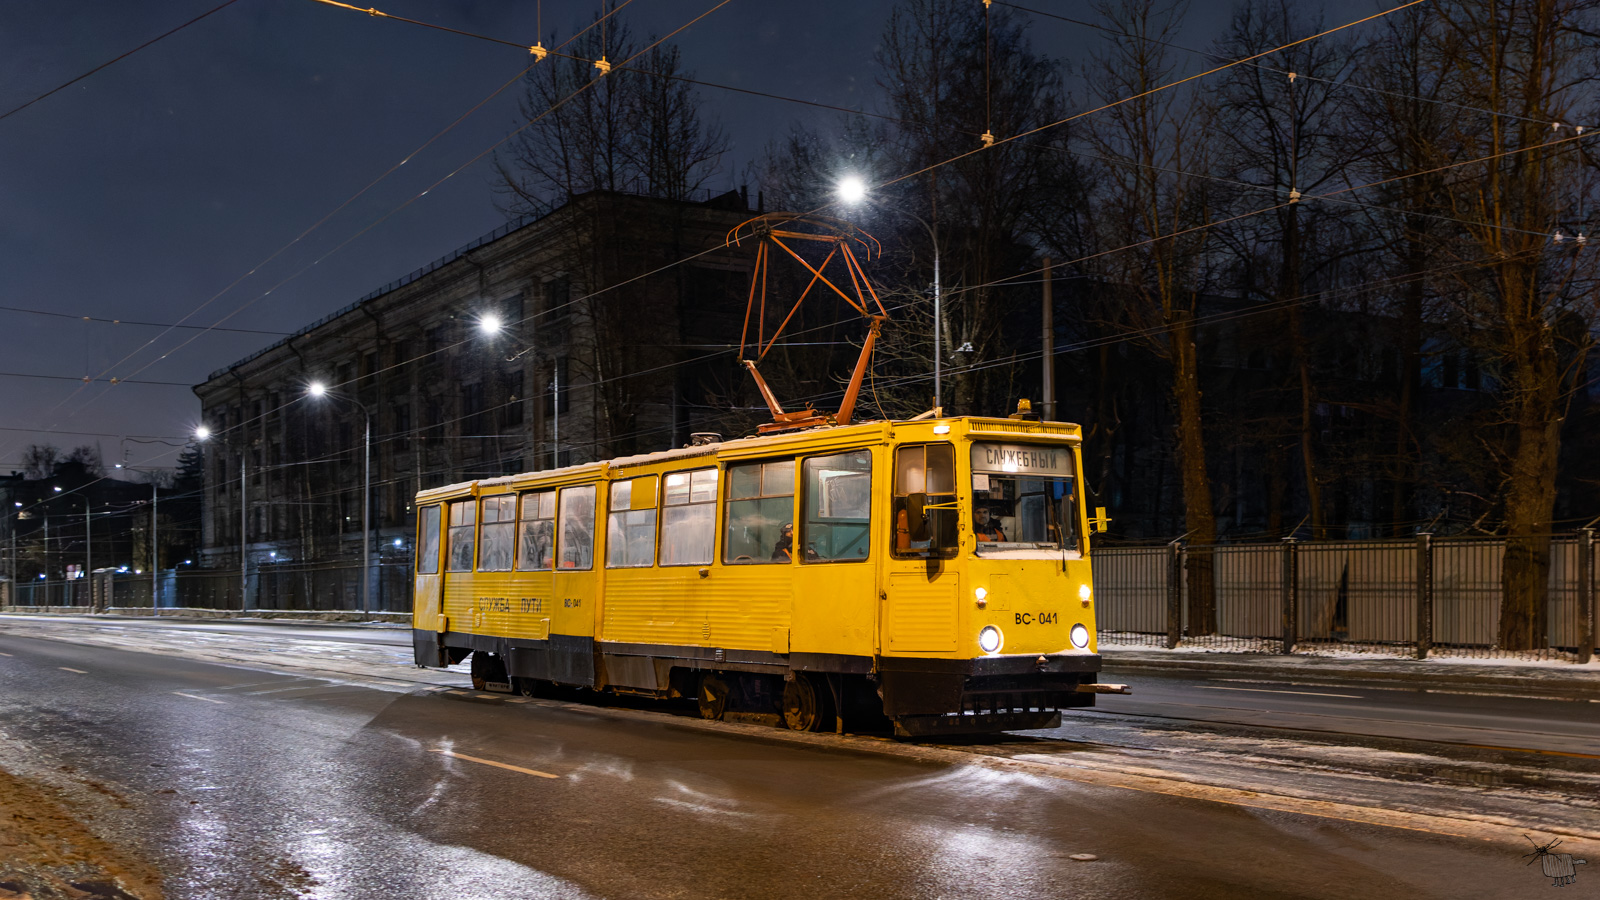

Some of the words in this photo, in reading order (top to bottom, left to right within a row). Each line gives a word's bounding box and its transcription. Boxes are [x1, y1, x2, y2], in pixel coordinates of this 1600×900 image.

[986, 448, 1057, 469] СЛУЖЕБНЫЙ
[479, 597, 510, 613] СЛУЖБА
[521, 598, 542, 613] ПУТИ
